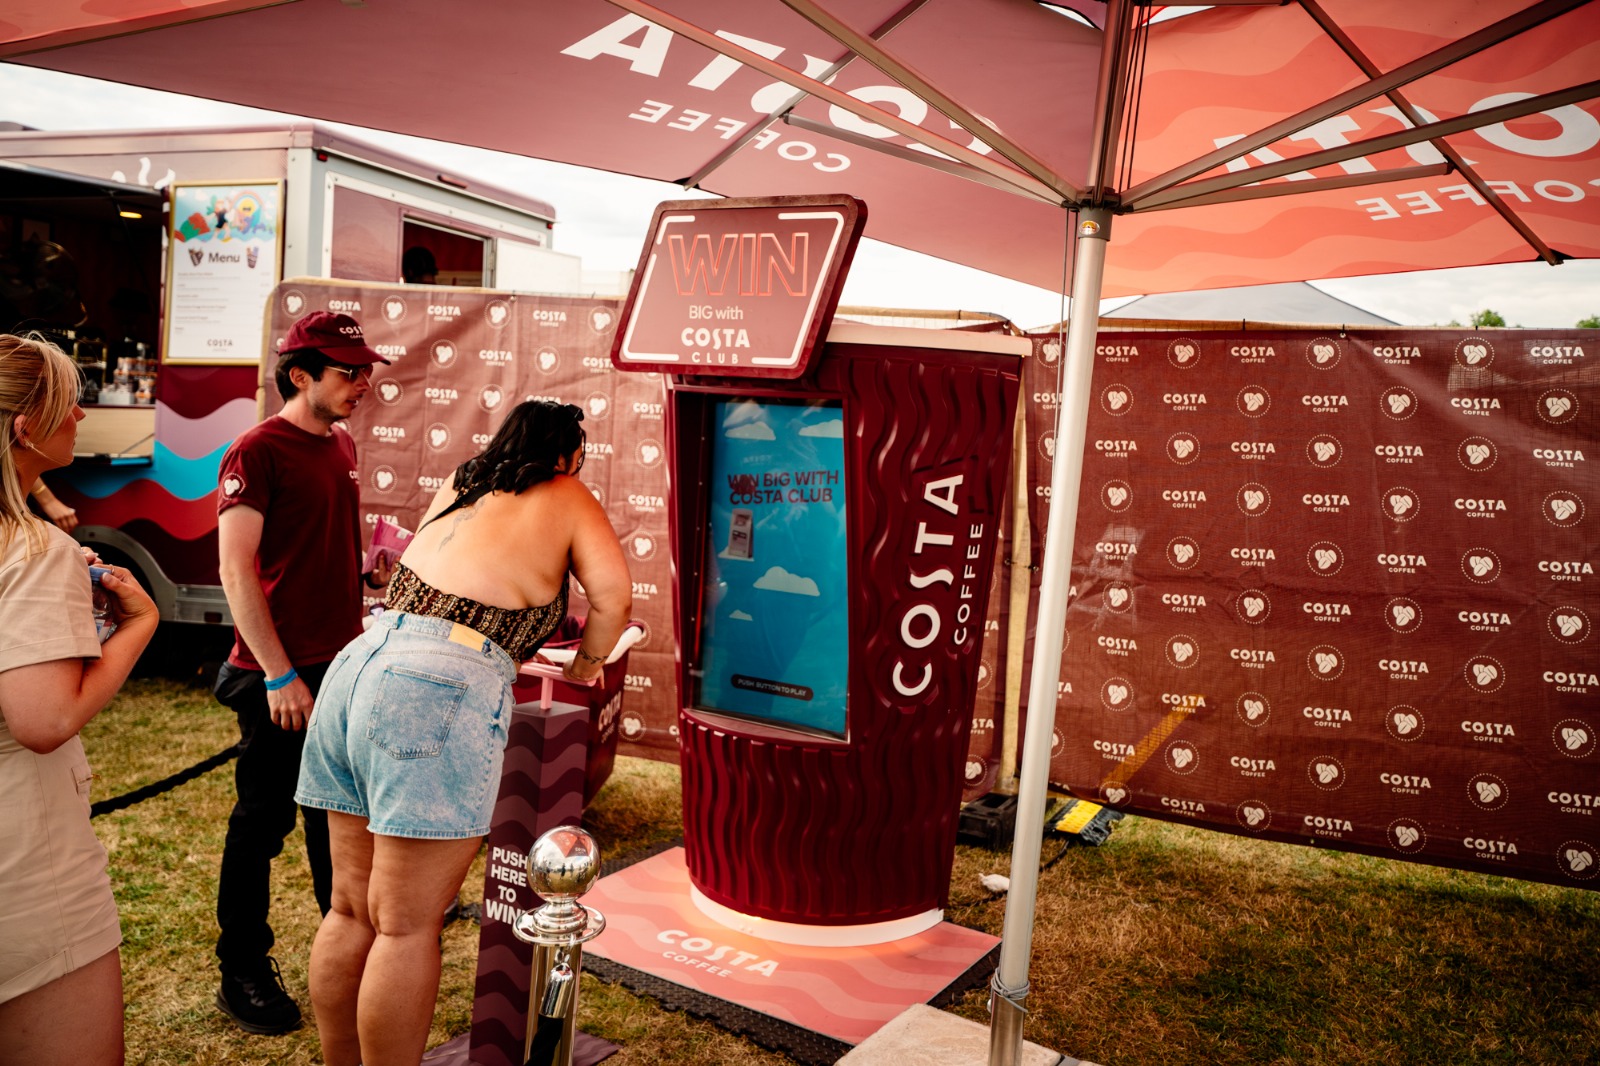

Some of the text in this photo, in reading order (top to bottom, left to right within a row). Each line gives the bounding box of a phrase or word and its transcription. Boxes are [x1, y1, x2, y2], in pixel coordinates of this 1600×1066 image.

[208, 252, 240, 264] Menu
[668, 232, 809, 297] WIN
[328, 300, 361, 312] COSTA
[427, 305, 461, 316] COSTA
[689, 305, 744, 320] BIG with
[533, 310, 567, 322] COSTA
[681, 328, 751, 350] COSTA
[374, 344, 407, 355] COSTA
[479, 350, 513, 361] COSTA
[1096, 346, 1139, 357] COSTA
[1231, 346, 1275, 357] COSTA
[1373, 346, 1421, 358] COSTA
[1530, 346, 1584, 358] COSTA
[692, 351, 739, 365] CLUB
[425, 388, 458, 399] COSTA
[1033, 393, 1063, 403] COS
[1163, 393, 1207, 405] COSTA
[1302, 395, 1348, 407] COSTA
[1450, 398, 1501, 410] COSTA
[372, 426, 405, 437] COSTA
[583, 443, 613, 454] OSTA
[1095, 440, 1137, 451] COSTA
[1231, 442, 1275, 454] COSTA
[1375, 445, 1424, 457] COSTA
[1533, 449, 1585, 461] COSTA
[418, 476, 444, 487] COST
[763, 472, 791, 487] BIG
[794, 469, 839, 486] WITH
[628, 494, 664, 507] COSTA
[730, 488, 833, 505] COSTA CLUB
[1162, 490, 1206, 502] COSTA
[1302, 494, 1350, 506] COSTA
[1454, 498, 1507, 511] COSTA
[1095, 542, 1137, 555] COSTA
[1231, 548, 1275, 561] COSTA
[1377, 553, 1427, 567] COSTA
[1538, 561, 1594, 575] COSTA
[631, 583, 657, 594] OSTA
[892, 474, 964, 697] COSTA
[953, 523, 984, 645] COFFEE
[1162, 593, 1206, 607] COSTA
[1303, 602, 1351, 616] COSTA
[1458, 611, 1511, 625] COSTA
[1097, 636, 1137, 650] COSTA
[1106, 649, 1128, 657] COFFEE
[1230, 648, 1275, 662] COSTA
[1378, 659, 1429, 674] COSTA
[624, 674, 652, 688] OSTA
[1543, 671, 1599, 686] COSTA
[738, 678, 755, 686] PUSH
[756, 682, 781, 692] BUTTON
[790, 688, 807, 696] PLAY
[1161, 693, 1206, 708] COSTA
[1303, 706, 1352, 722] COSTA
[971, 718, 994, 729] STA
[1461, 721, 1515, 736] COSTA
[1473, 735, 1503, 743] COFFEE
[1093, 740, 1135, 757] COSTA
[1102, 754, 1125, 762] COFFEE
[1230, 756, 1276, 771] COSTA
[1380, 773, 1431, 789] COSTA
[1391, 787, 1420, 795] COFFEE
[1161, 797, 1205, 813] COSTA
[1548, 792, 1600, 808] COSTA
[1171, 808, 1196, 817] COFFEE
[1560, 806, 1592, 815] COFFEE
[1304, 815, 1353, 832] COSTA
[1315, 829, 1342, 838] COFFEE
[1463, 837, 1518, 855] COSTA
[492, 847, 528, 870] PUSH
[1475, 852, 1506, 861] COFFEE
[491, 863, 527, 887] HERE
[498, 884, 517, 903] TO
[656, 929, 780, 977] COSTA
[662, 950, 733, 977] COFFEE
